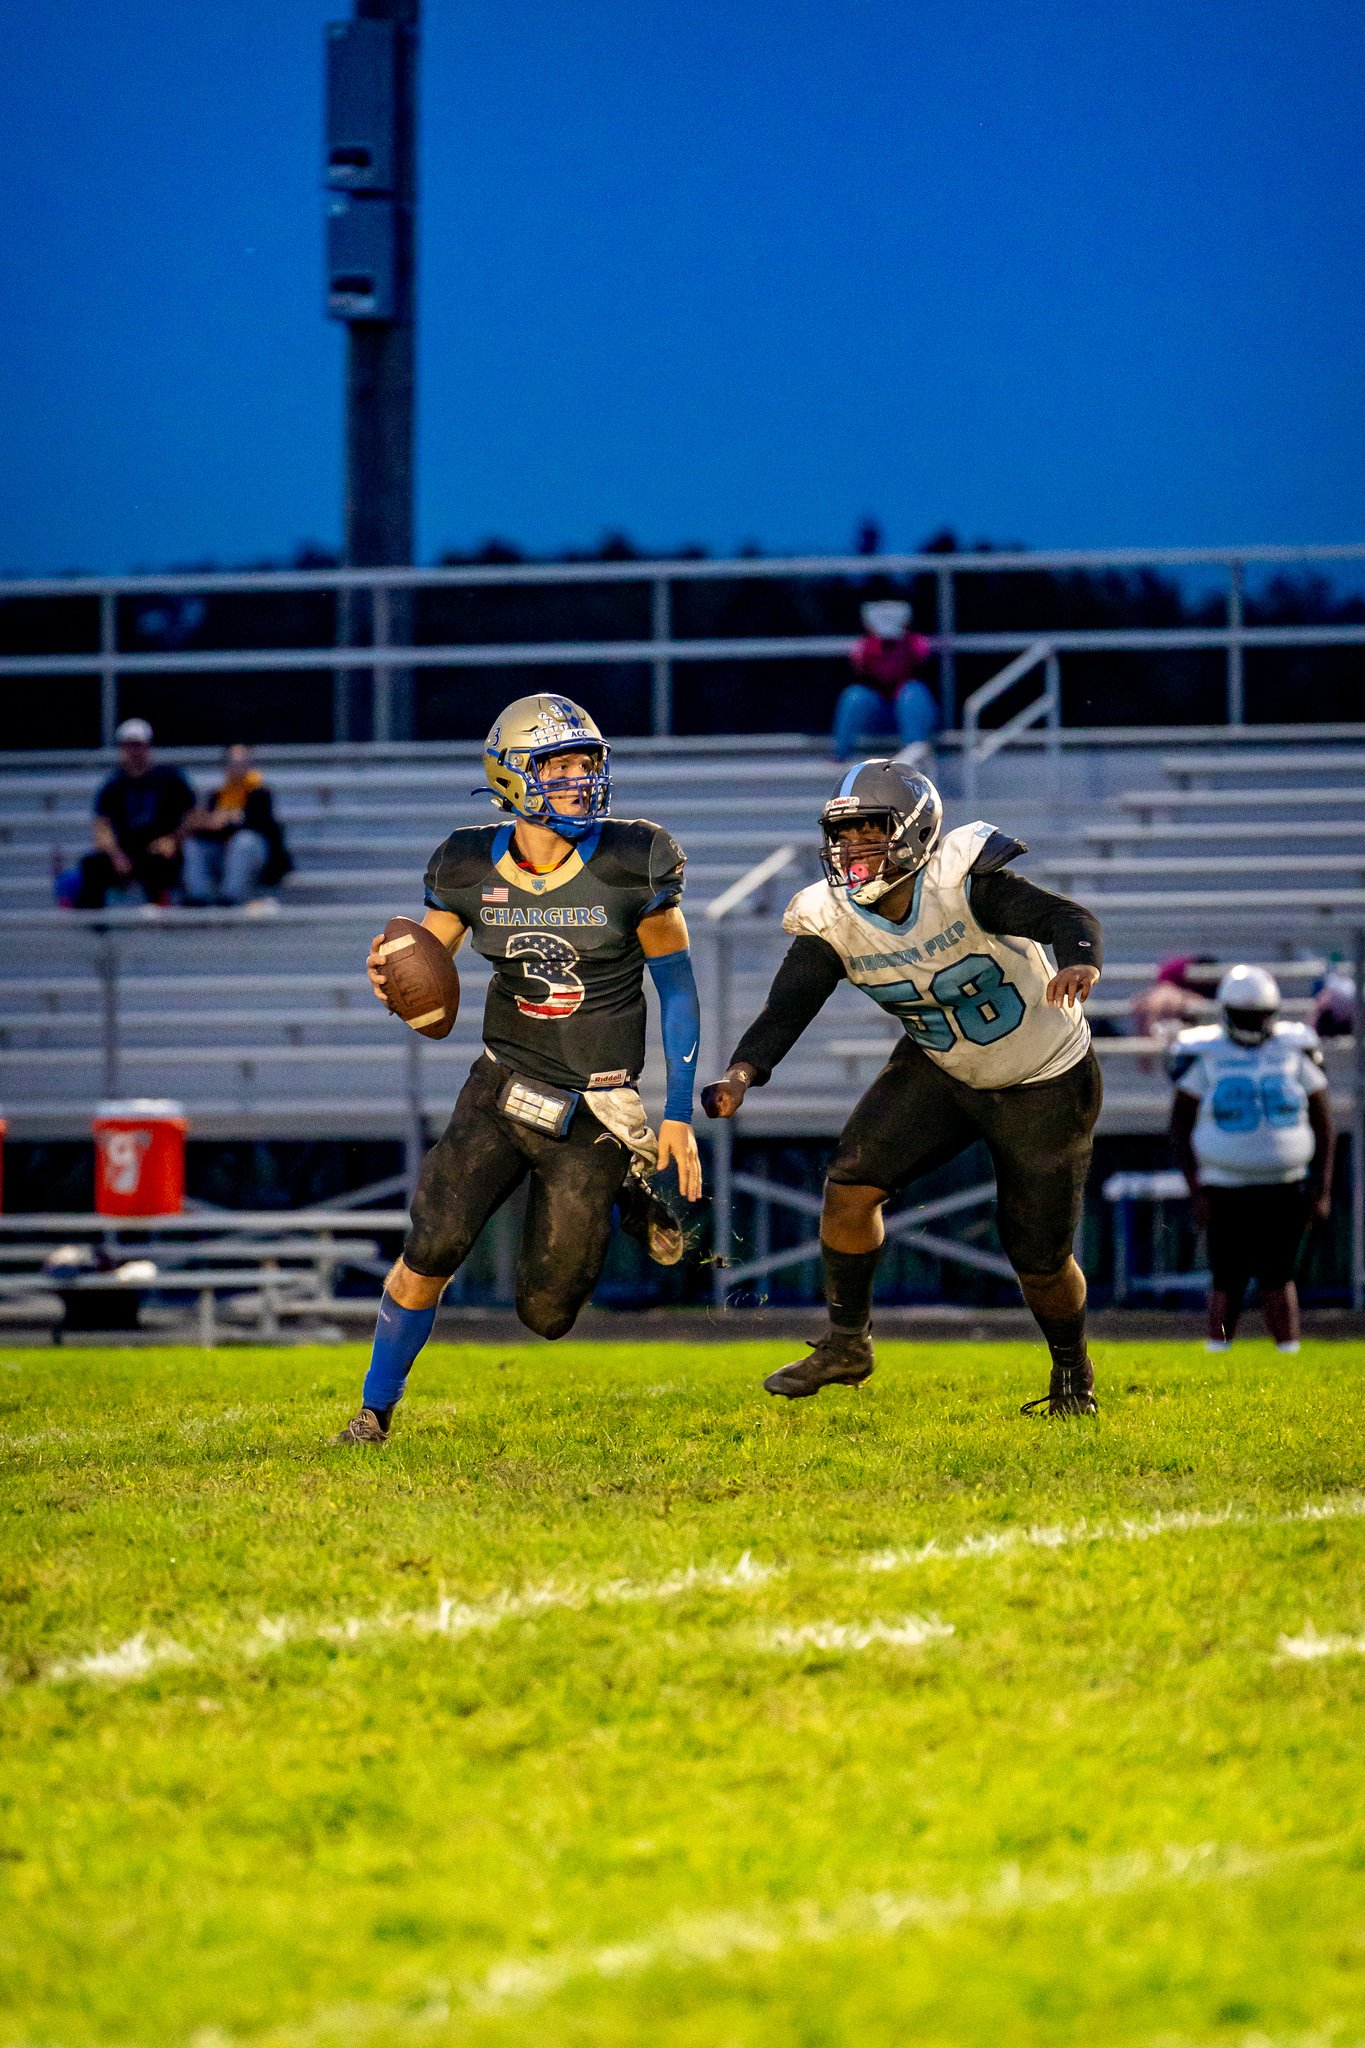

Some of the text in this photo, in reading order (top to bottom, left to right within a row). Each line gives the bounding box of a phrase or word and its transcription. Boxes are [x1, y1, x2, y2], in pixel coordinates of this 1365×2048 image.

[492, 725, 502, 747] 3
[571, 730, 588, 738] ACC
[480, 906, 607, 926] CHARGERS
[923, 920, 966, 957] PREP
[505, 931, 585, 1019] 3
[857, 953, 1026, 1052] 58
[595, 1074, 622, 1082] Riddell
